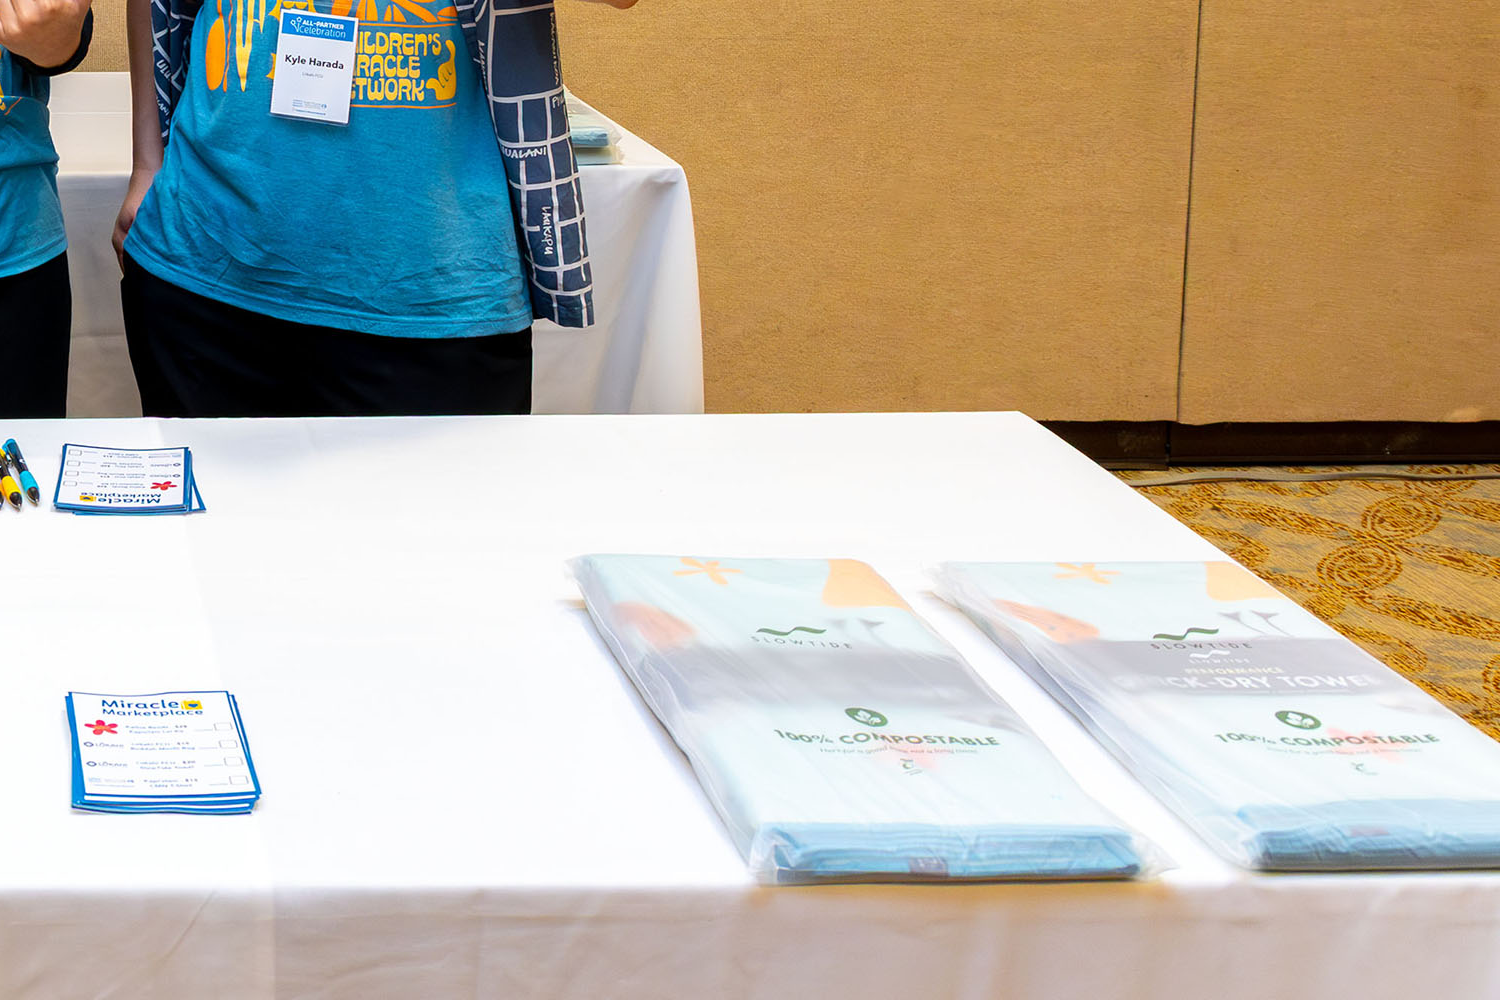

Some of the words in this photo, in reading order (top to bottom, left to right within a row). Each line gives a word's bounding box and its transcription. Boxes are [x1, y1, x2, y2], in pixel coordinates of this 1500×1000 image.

[302, 19, 344, 30] ALL-PARTNER
[300, 25, 346, 39] Celebration
[359, 31, 442, 56] ILDREN'S
[285, 54, 306, 65] Kyle
[309, 58, 344, 70] Harada
[357, 54, 420, 78] RACLE
[80, 491, 161, 500] Marketplace
[97, 495, 161, 505] Miracle
[751, 635, 853, 650] SLOWTIDE
[1150, 642, 1253, 650] SLOWTIDE
[1184, 667, 1285, 675] PERFORMANCE
[102, 699, 179, 709] Miracle
[102, 708, 203, 717] Marketplace
[774, 729, 834, 744] 100%
[839, 731, 1001, 746] COMPOSTABLE
[1215, 732, 1277, 744] 100%
[1280, 733, 1441, 747] COMPOSTABLE
